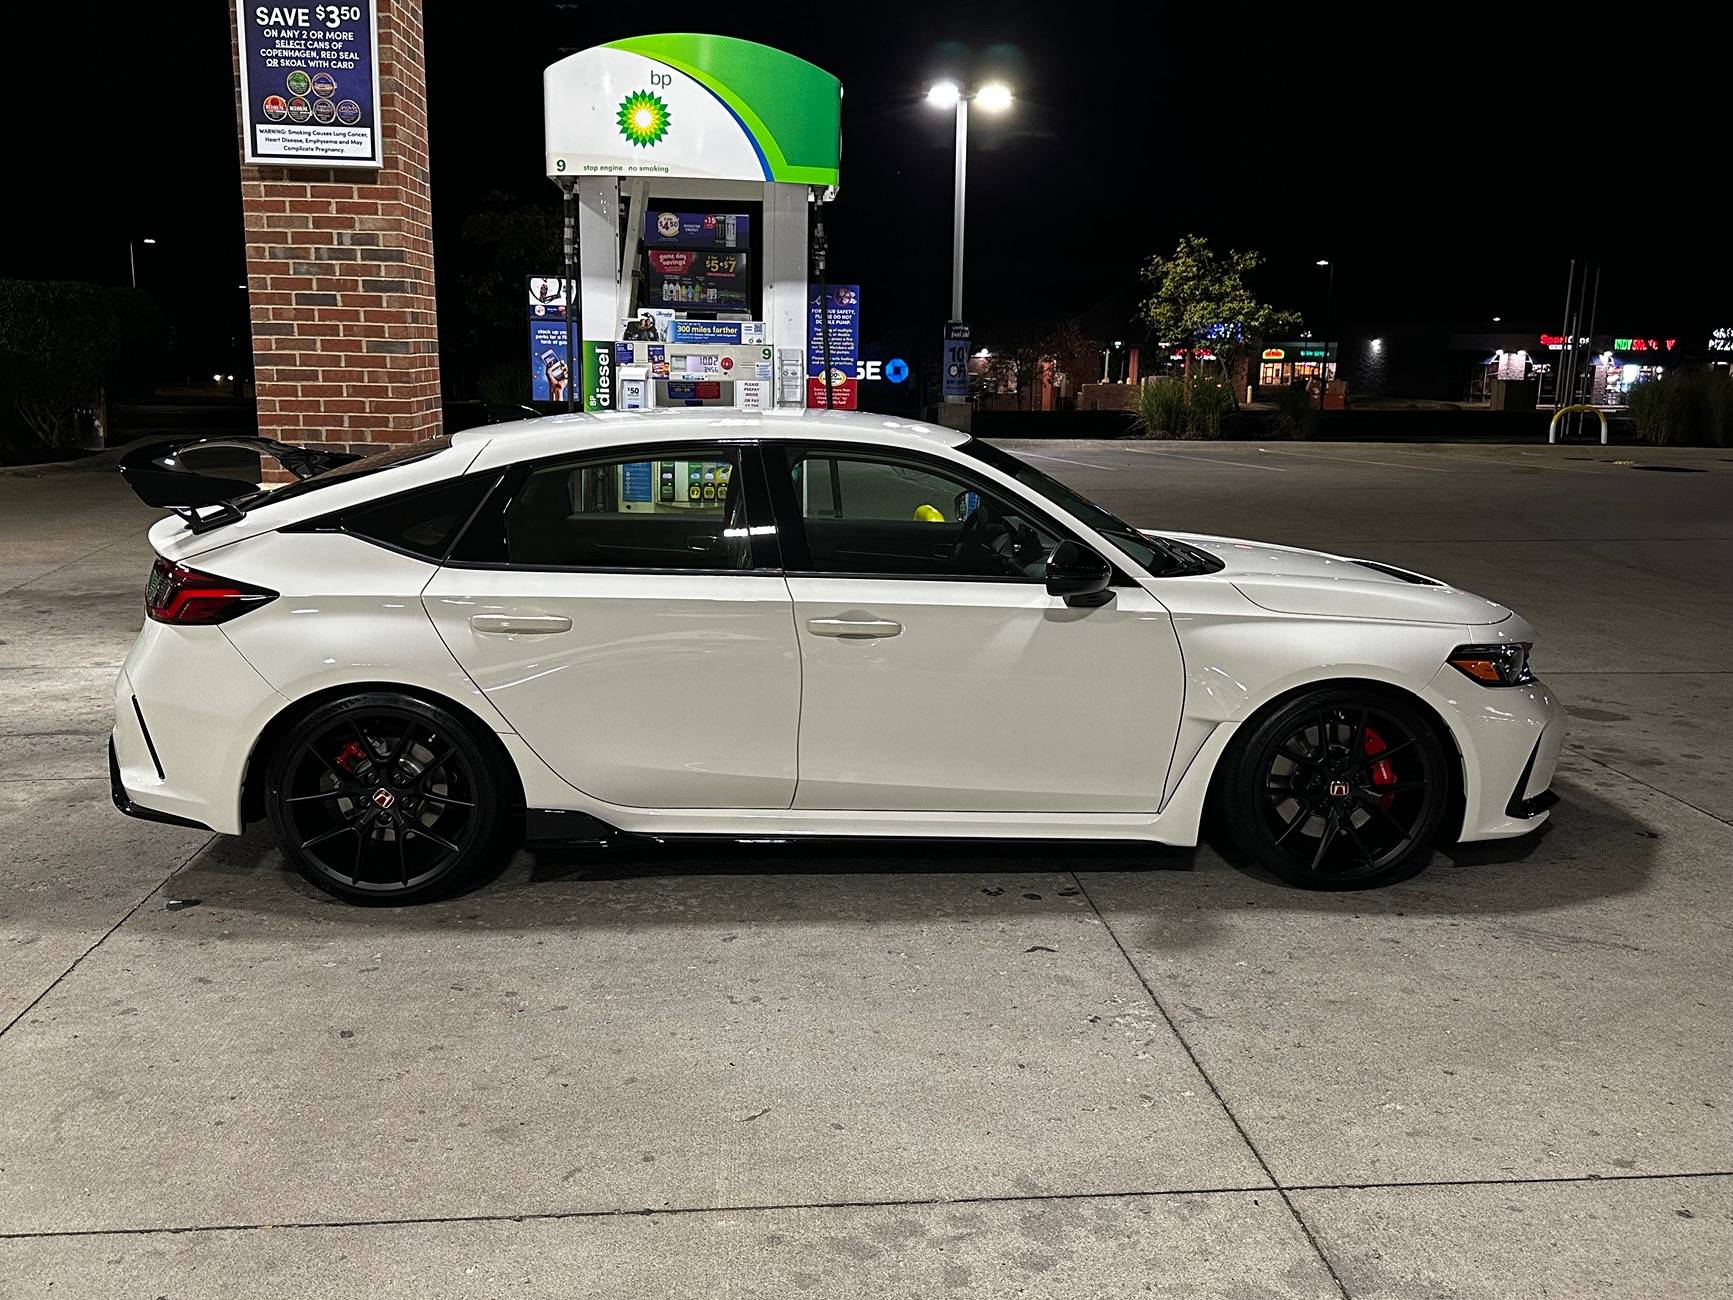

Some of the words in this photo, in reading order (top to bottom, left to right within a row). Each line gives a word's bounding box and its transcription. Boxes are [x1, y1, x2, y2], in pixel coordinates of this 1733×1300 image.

[256, 6, 310, 26] SAVE
[264, 28, 278, 38] ON
[280, 30, 300, 38] ANY
[302, 30, 308, 38] 2
[310, 30, 324, 39] OR
[326, 32, 354, 40] MORE
[276, 40, 305, 48] SELECT
[307, 41, 330, 49] CANS
[260, 49, 319, 59] COPENHAGEN,
[321, 51, 338, 59] RED
[340, 52, 360, 60] SEAL
[266, 59, 279, 67] OR
[280, 59, 306, 67] SKOAL
[308, 60, 329, 68] WITH
[331, 60, 354, 69] CARD
[651, 70, 672, 89] bp
[556, 159, 566, 172] 9
[640, 165, 669, 173] smoking
[692, 326, 711, 334] miles
[713, 326, 738, 334] farther
[762, 348, 771, 360] 9
[595, 349, 610, 406] diesel
[590, 395, 597, 406] BP
